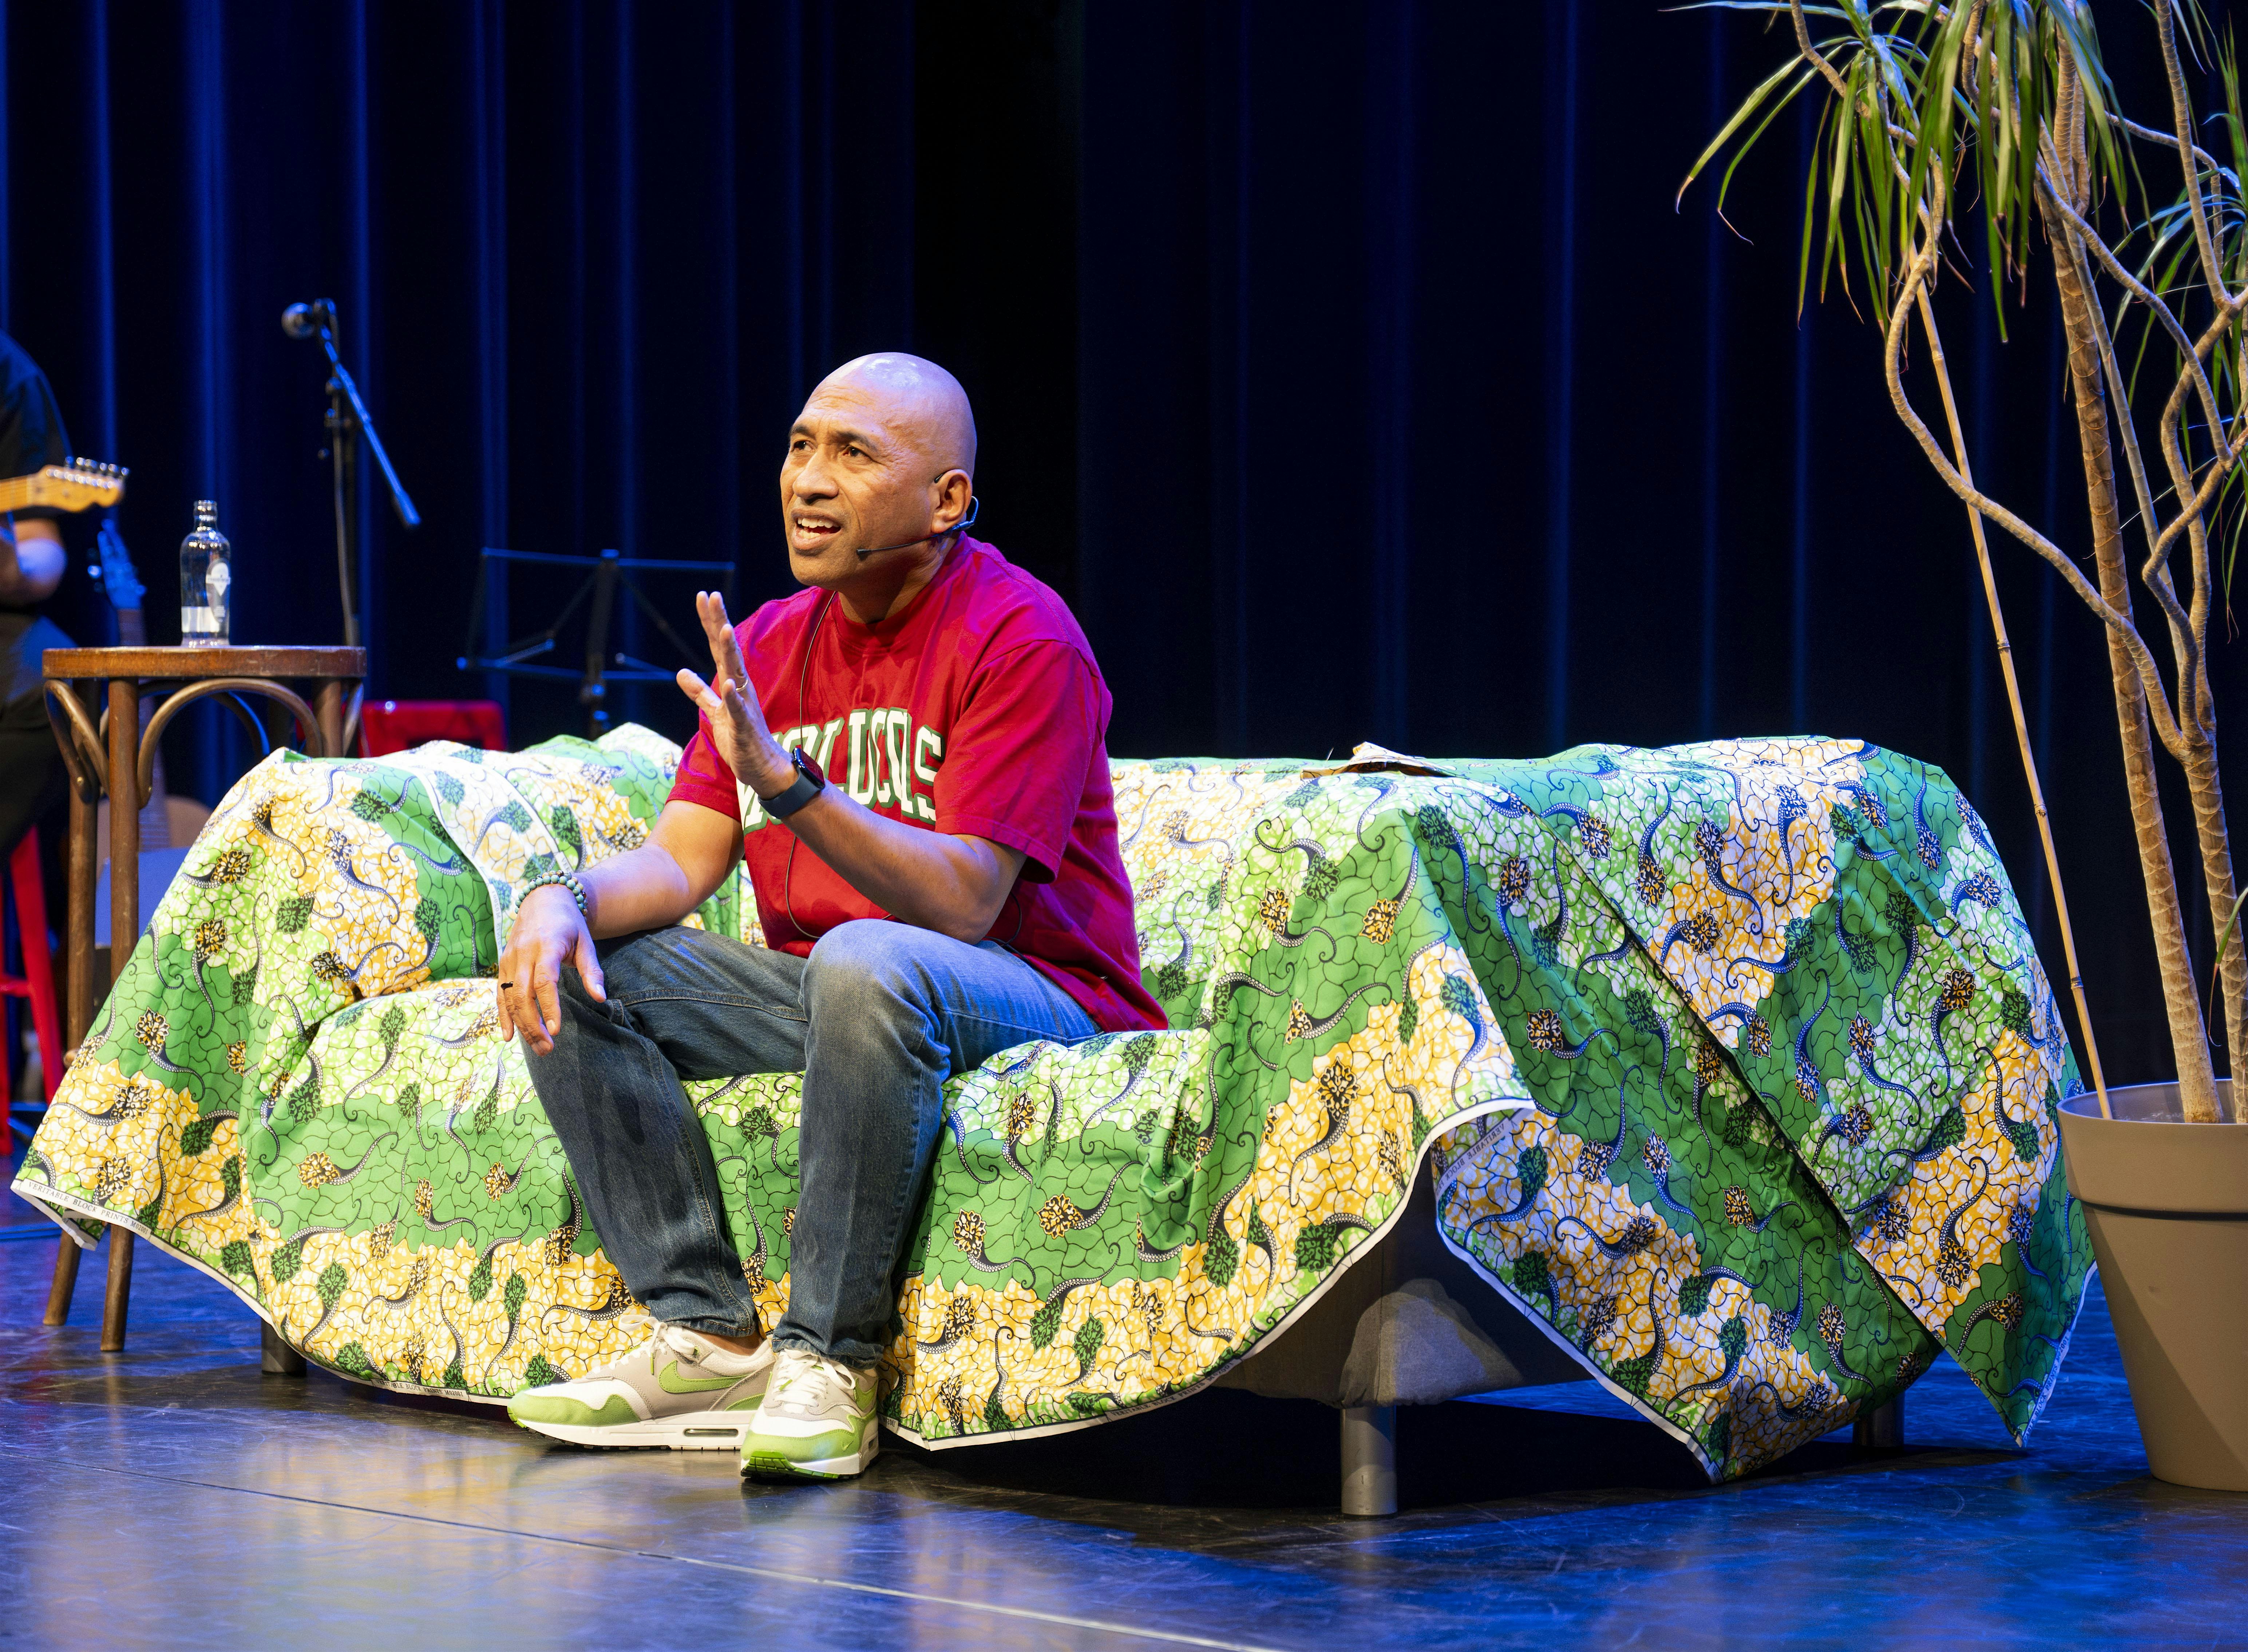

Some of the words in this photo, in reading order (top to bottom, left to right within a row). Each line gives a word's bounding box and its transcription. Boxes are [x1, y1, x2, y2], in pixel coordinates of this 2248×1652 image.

[29, 1182, 70, 1202] VERITABLE
[73, 1199, 96, 1213] BLOCK
[101, 1210, 129, 1224] PRINTS
[130, 1220, 148, 1235] M02001
[405, 1383, 421, 1391] BLOCK
[2034, 1394, 2047, 1417] BLOCK
[2045, 1364, 2058, 1391] PRINTS
